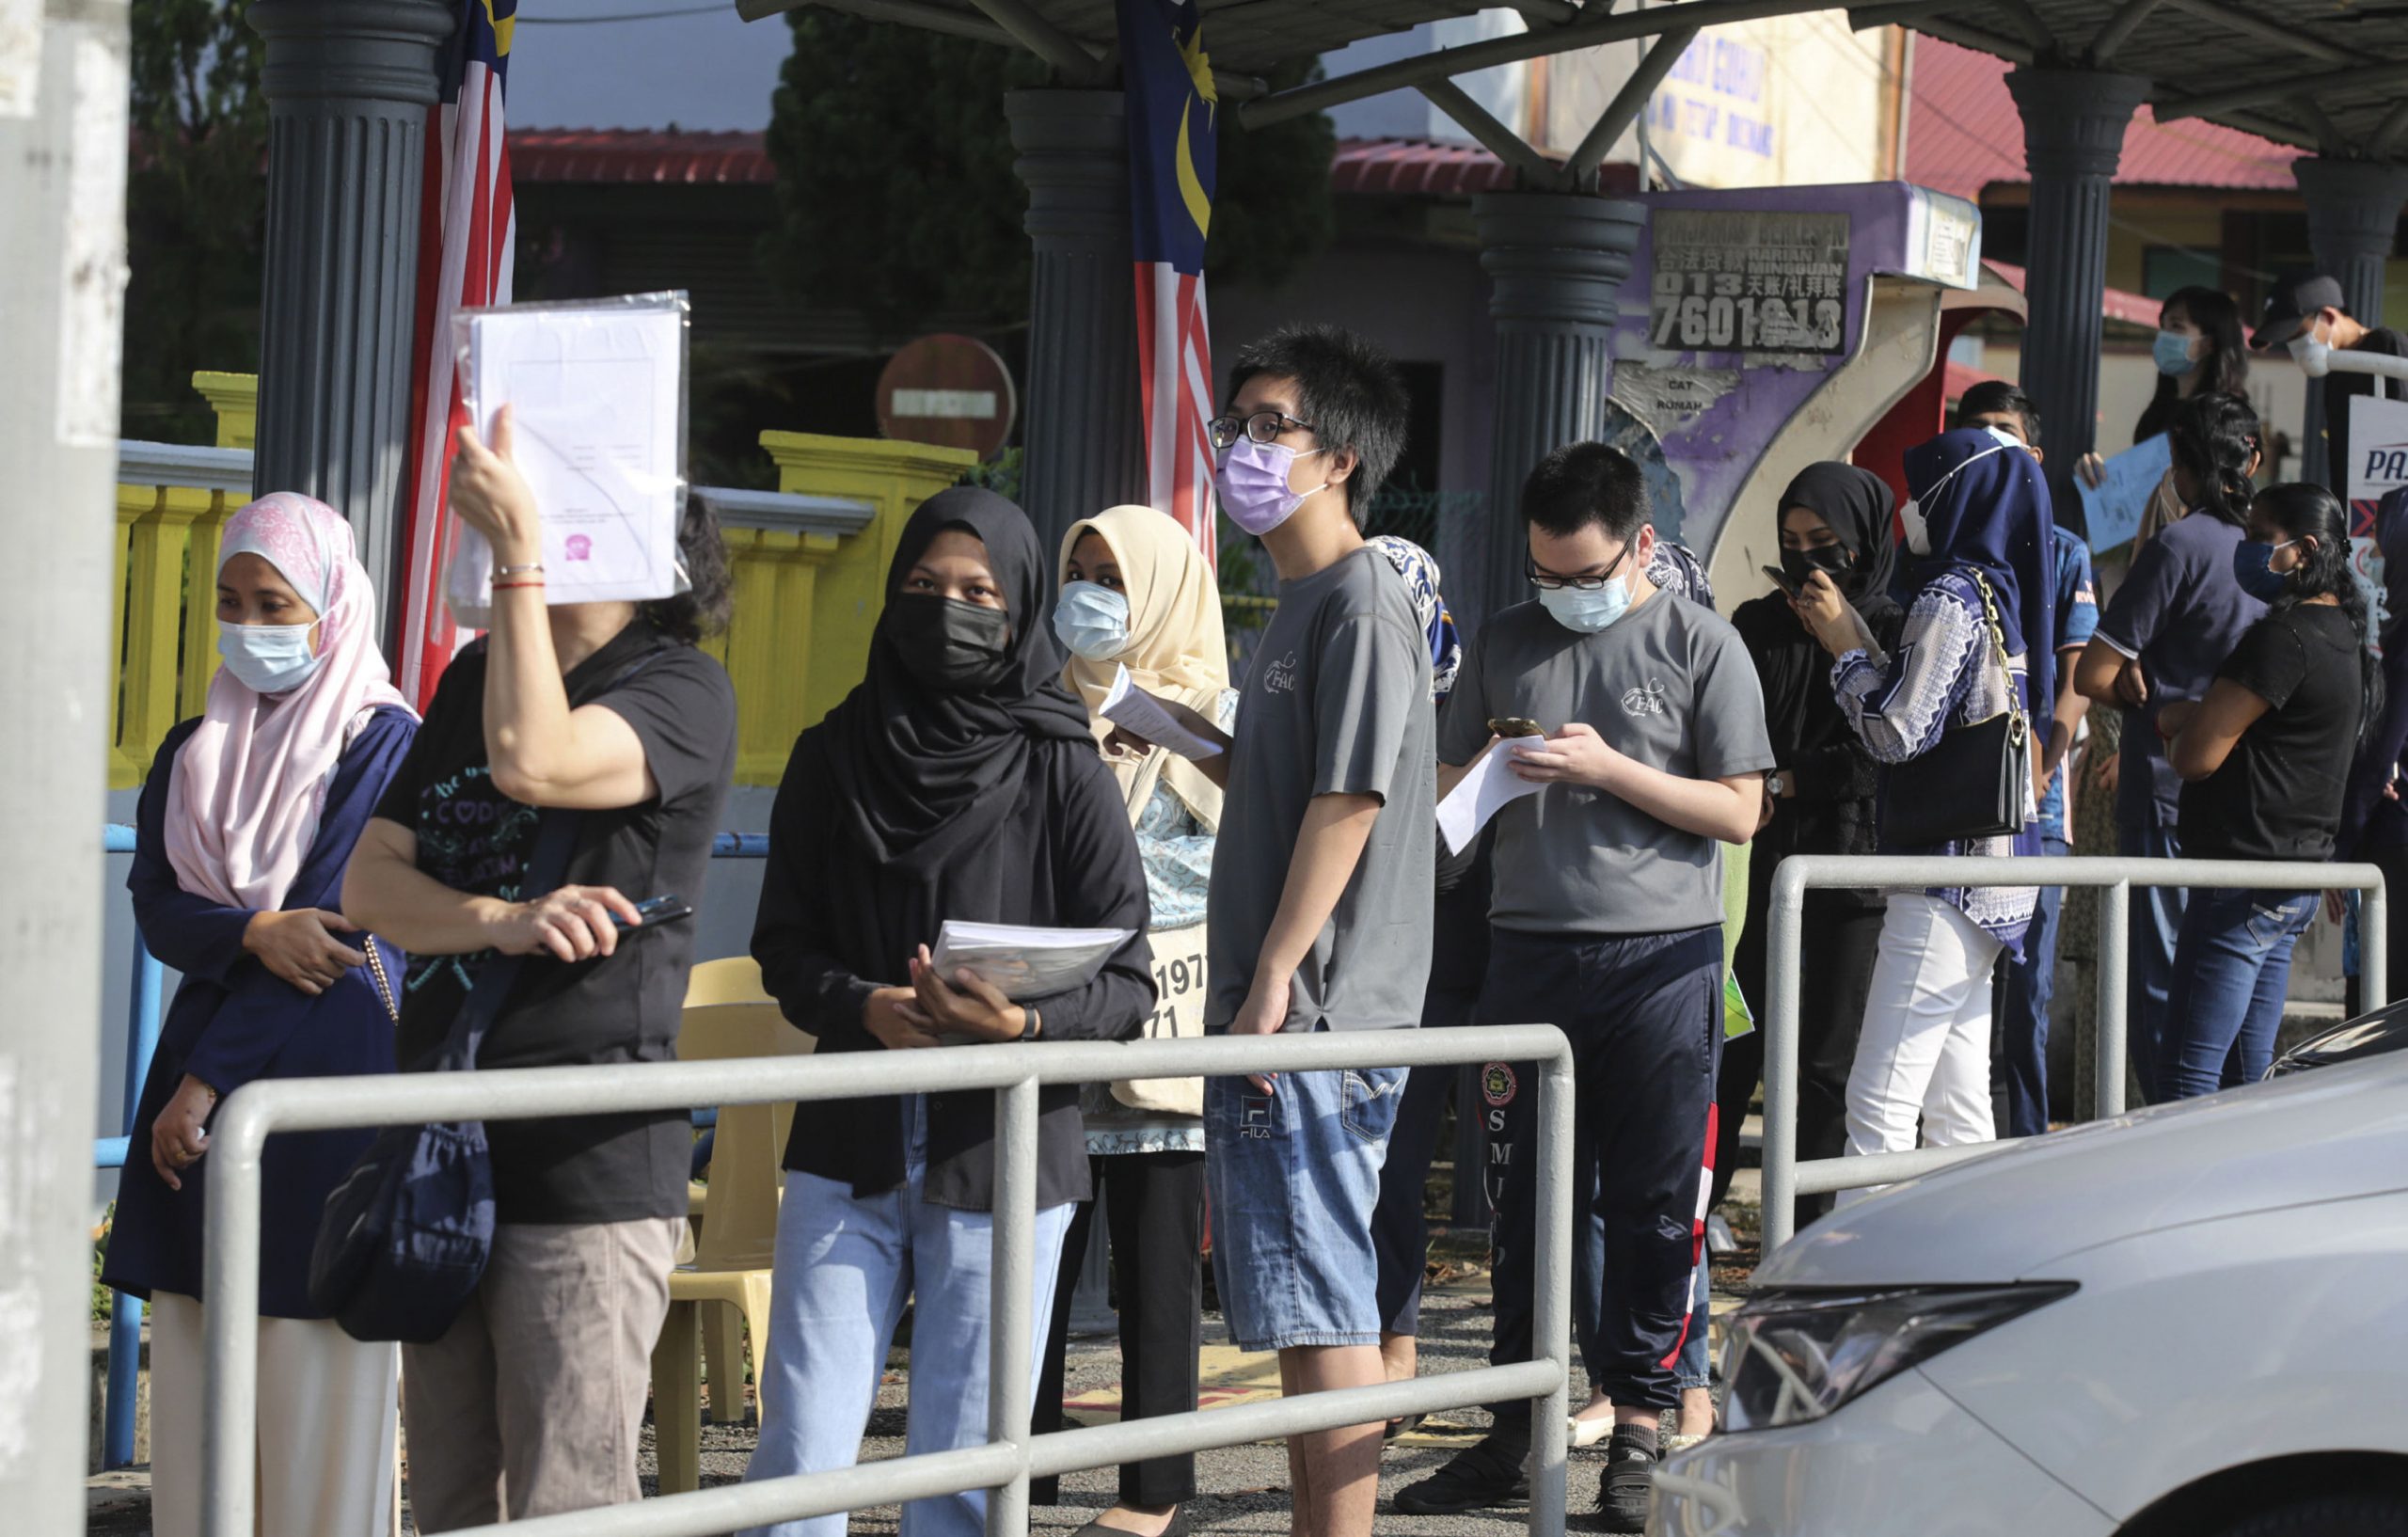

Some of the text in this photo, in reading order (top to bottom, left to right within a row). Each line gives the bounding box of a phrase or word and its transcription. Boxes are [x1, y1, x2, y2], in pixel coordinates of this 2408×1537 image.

[1749, 248, 1814, 261] HARIAN
[1748, 261, 1843, 276] MINGGUAN
[1656, 272, 1742, 295] 013
[1669, 380, 1693, 390] CAT
[1156, 954, 1208, 1000] 197
[1241, 1127, 1271, 1138] FILA
